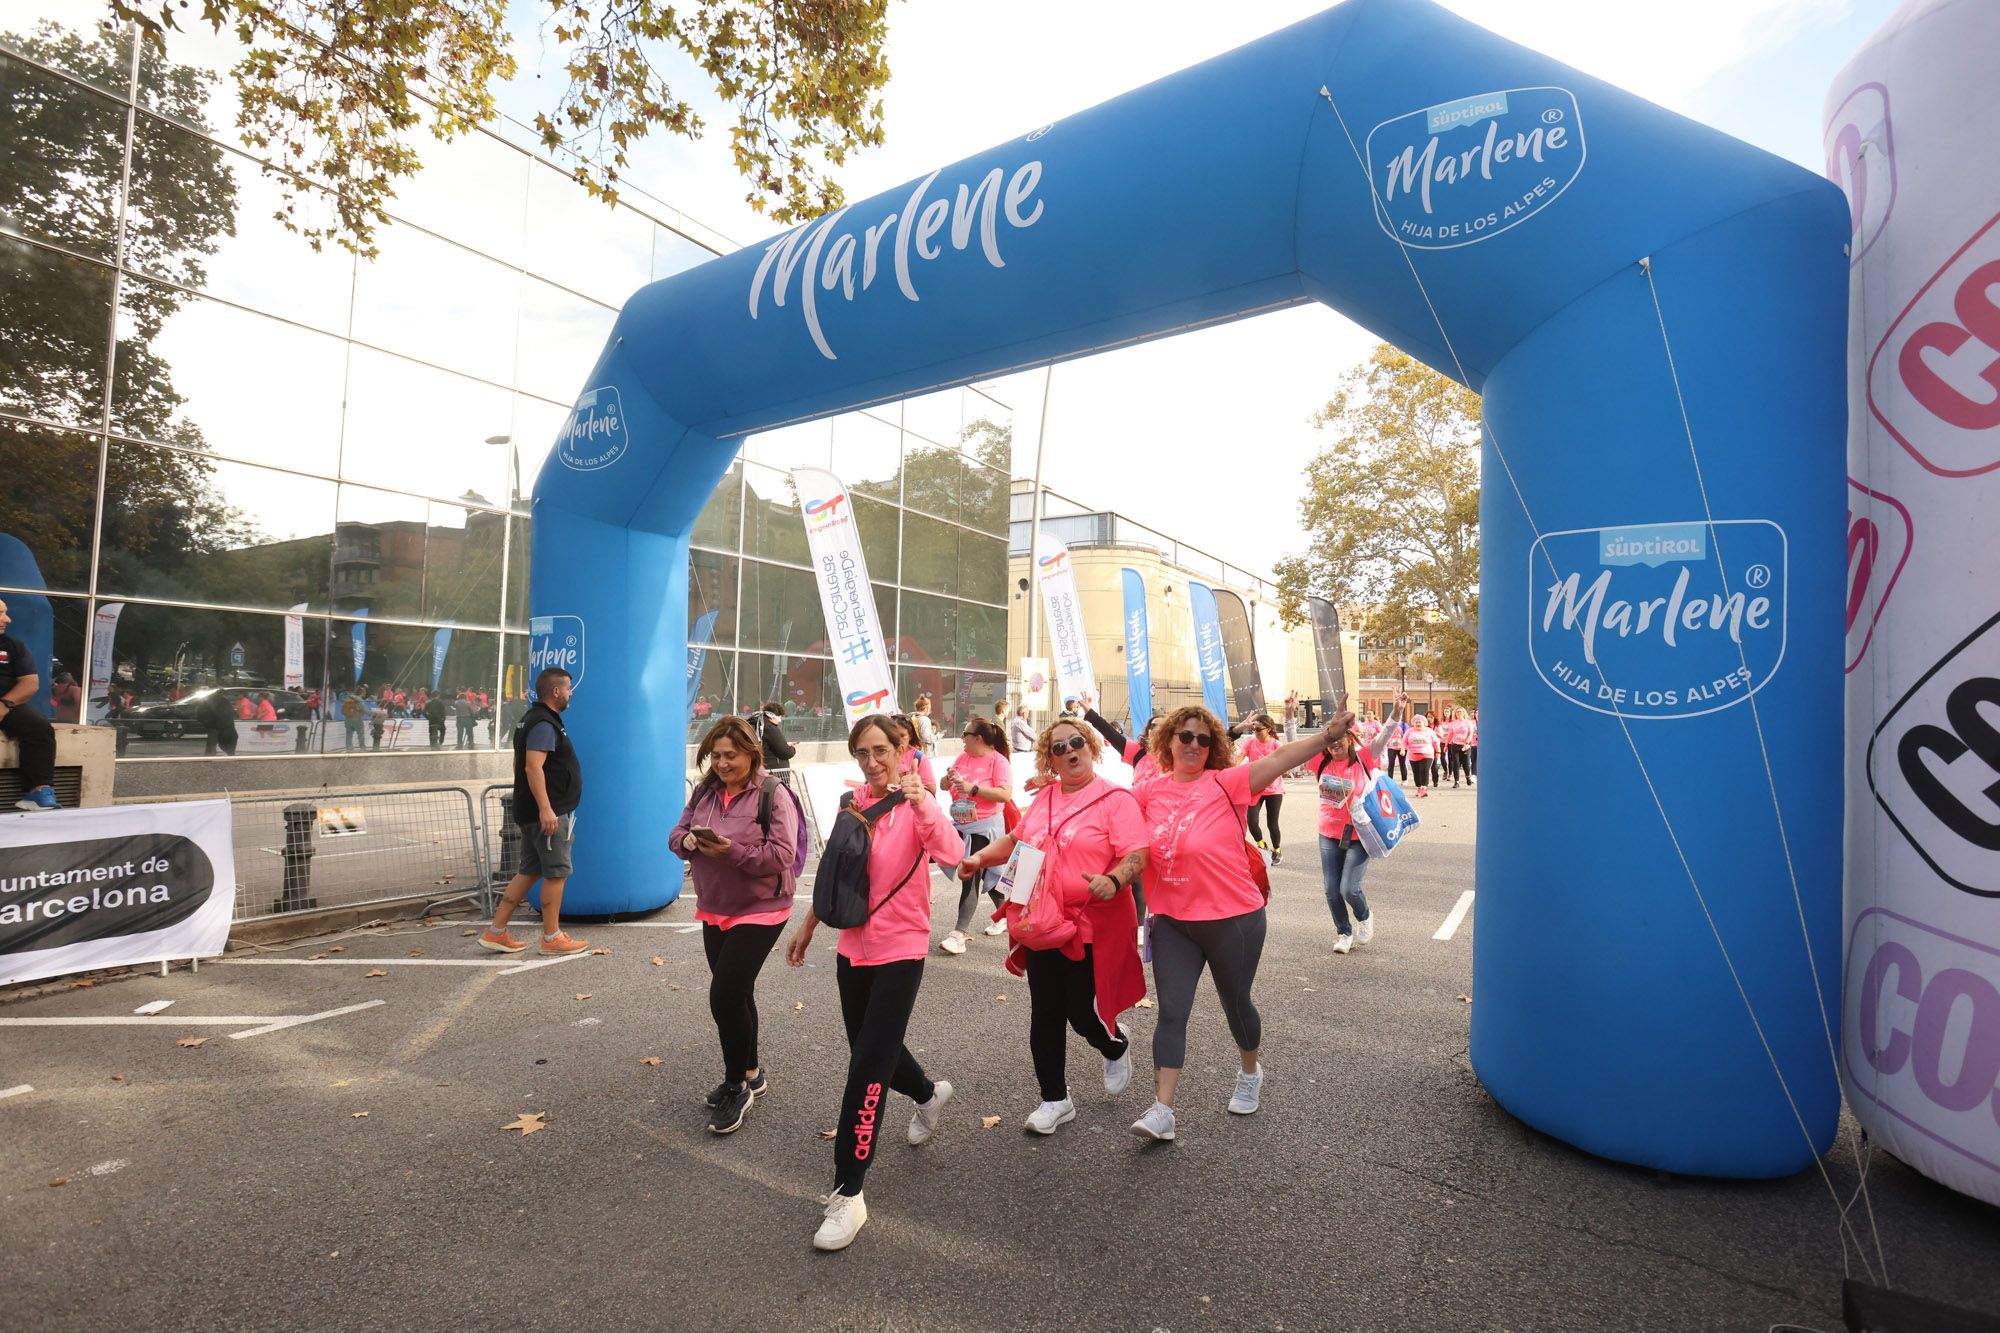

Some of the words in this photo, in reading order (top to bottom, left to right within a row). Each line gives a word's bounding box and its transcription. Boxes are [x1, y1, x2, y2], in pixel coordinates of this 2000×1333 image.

[1386, 120, 1568, 214] Marlene
[1401, 220, 1433, 239] HIJA
[1438, 224, 1460, 239] DE
[1465, 212, 1498, 235] LOS
[1503, 176, 1557, 219] ALPES
[749, 160, 1044, 360] Marlene
[559, 407, 620, 452] Marlene
[585, 458, 599, 466] LOS
[600, 445, 619, 463] ALPES
[1542, 566, 1770, 665] Marlene
[1552, 661, 1592, 694] HIJA
[1597, 684, 1627, 704] DE
[1634, 690, 1678, 706] LOS
[1686, 666, 1752, 704] ALPES
[141, 856, 170, 875] de
[854, 1082, 882, 1160] adidas
